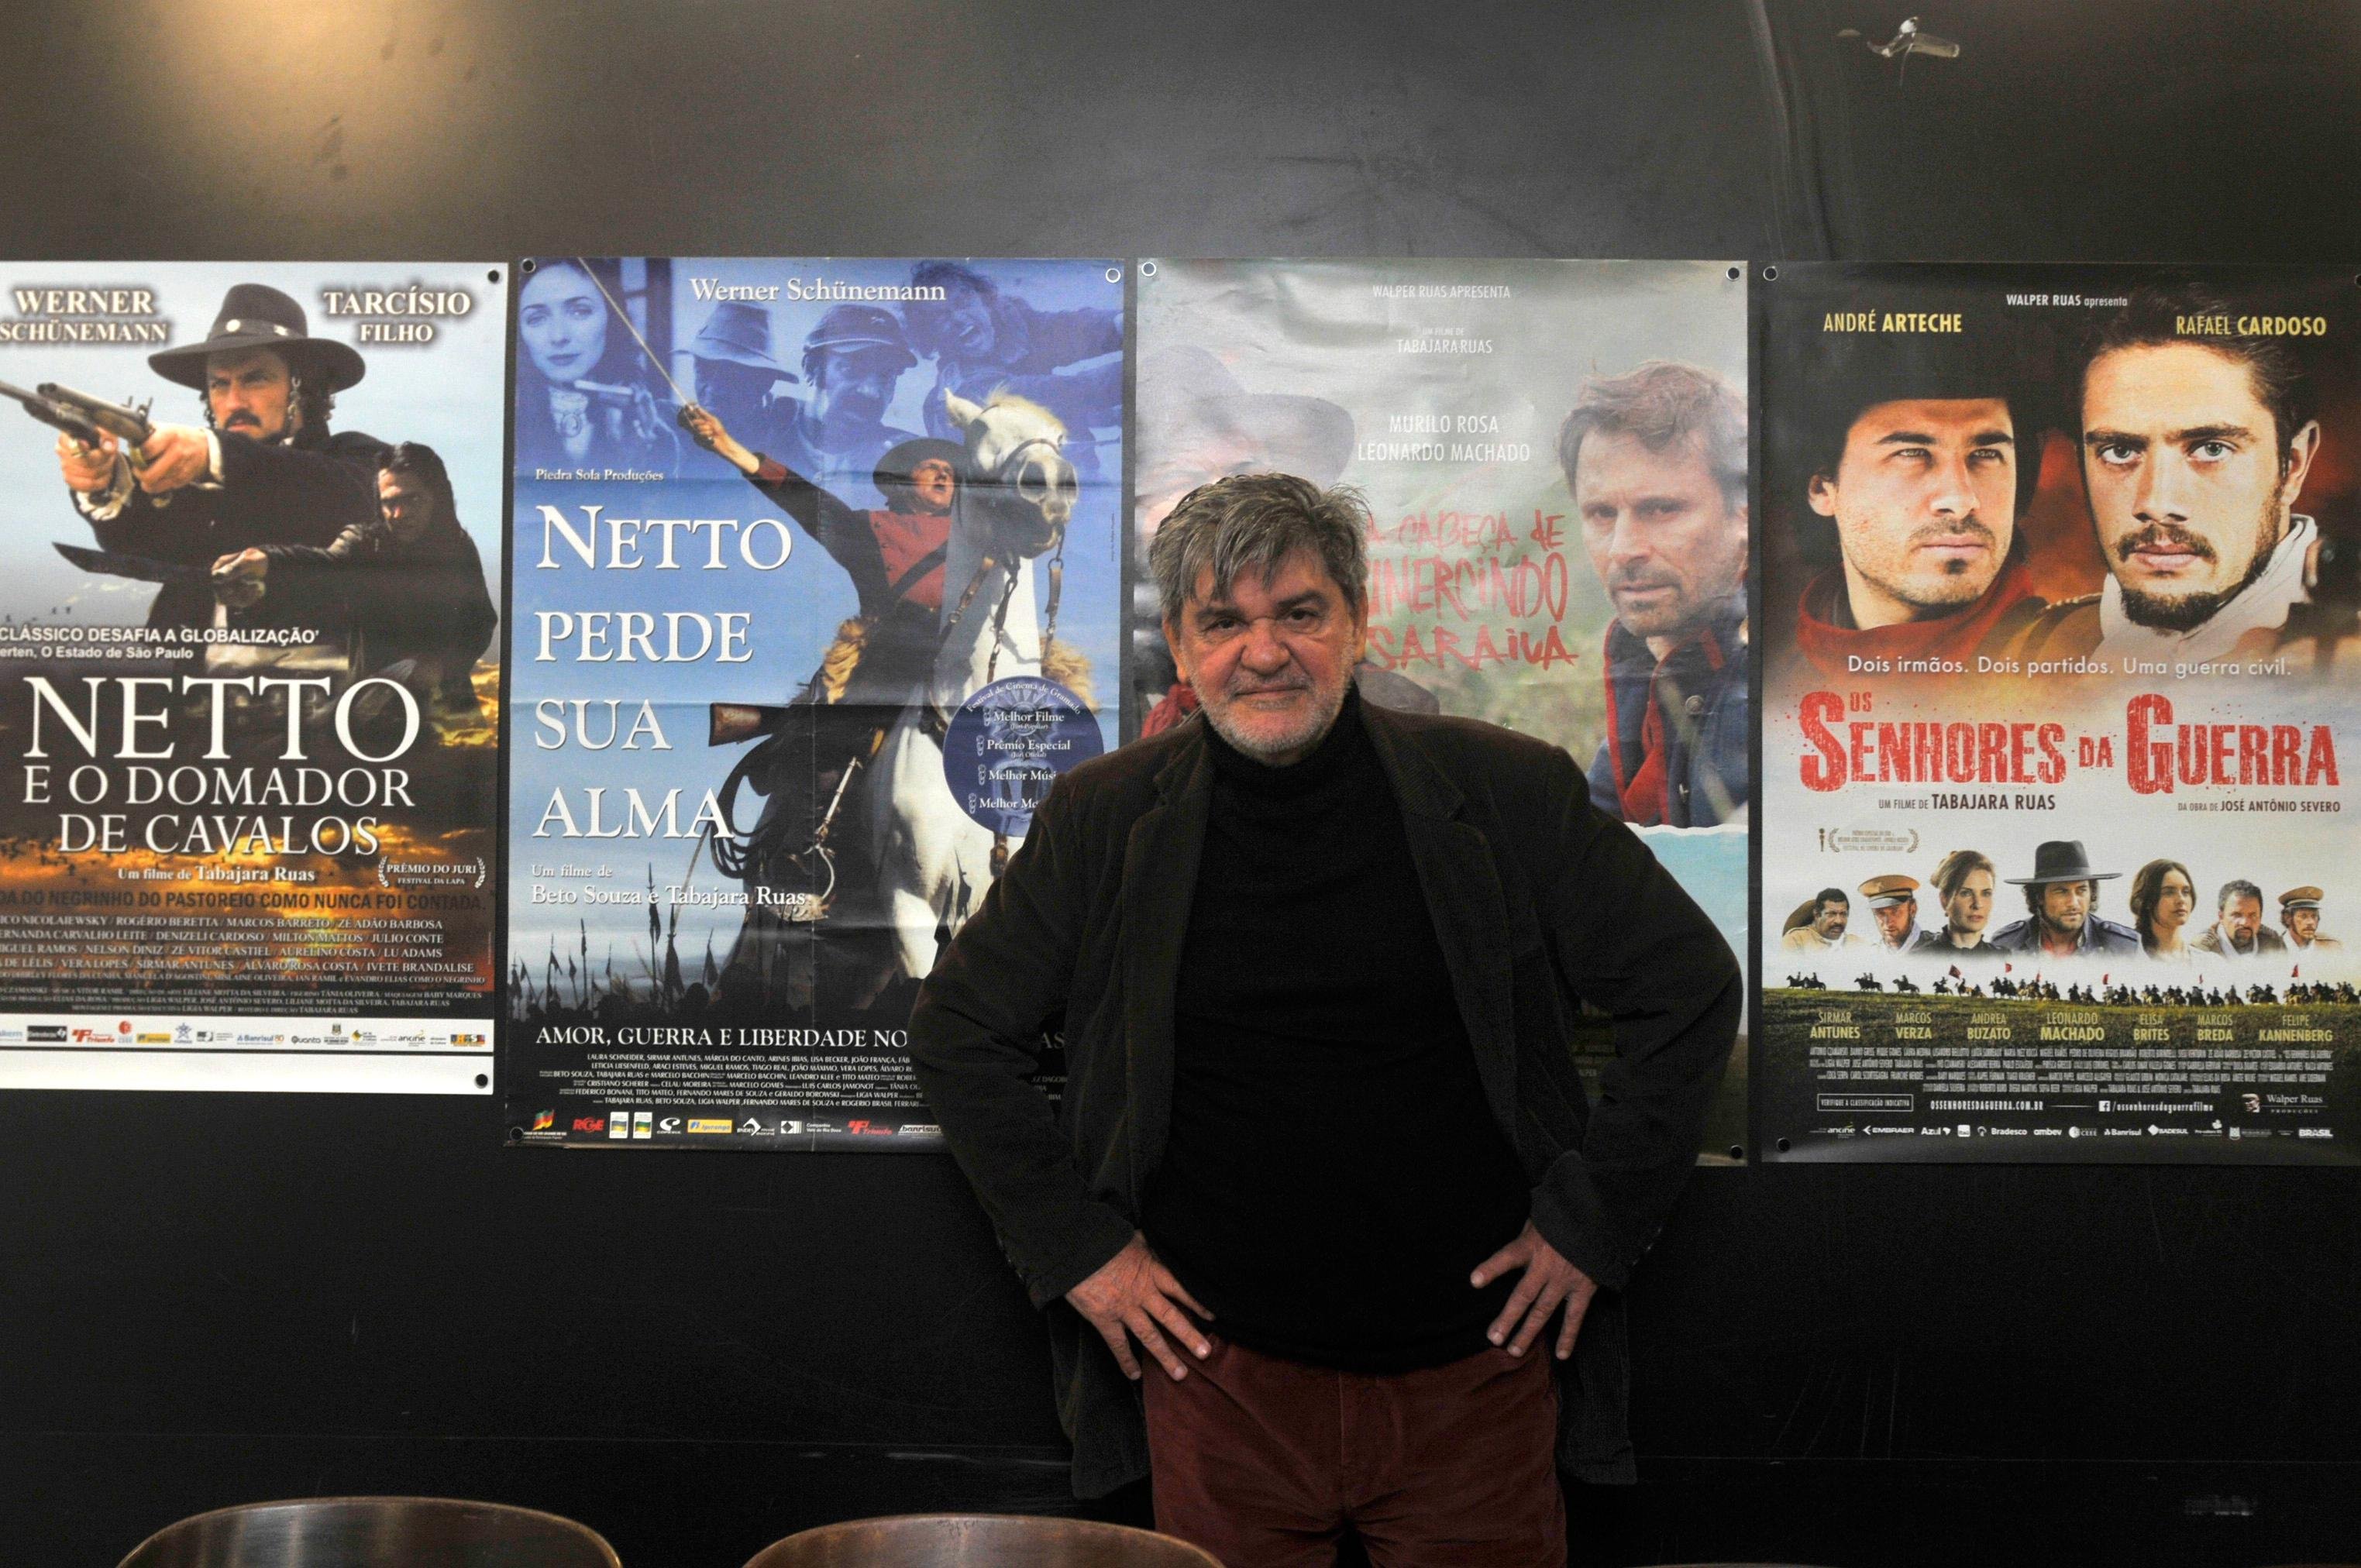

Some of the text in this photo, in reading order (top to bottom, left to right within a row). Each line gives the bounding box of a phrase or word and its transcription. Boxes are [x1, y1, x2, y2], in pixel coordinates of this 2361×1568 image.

[690, 279, 945, 301] Werner Schünemann
[1372, 285, 1510, 298] WALPER RUAS APRESENTA
[15, 290, 153, 314] WERNER
[324, 287, 471, 315] TARCÍSIO
[2007, 294, 2128, 309] WALPER RUAS apresenta
[1823, 309, 1962, 333] ANDRÉ ARTECHE
[2176, 316, 2327, 336] RAFAEL CARDOSO
[0, 319, 167, 341] SCHÜNEMANN
[360, 324, 433, 342] FILHO
[1396, 339, 1492, 354] TABAJARA RUAS
[1389, 415, 1499, 433] MURILO ROSA
[1358, 443, 1530, 462] LEONARDO MACHADO
[535, 468, 664, 483] Piedra Sola Produções
[535, 505, 792, 571] NETTO
[1398, 509, 1517, 554] CABEÇA
[0, 624, 83, 642] CLÁSSICO
[88, 628, 160, 642] DESAFIA
[163, 628, 176, 642] A
[534, 611, 753, 663] PERDE
[41, 646, 194, 658] O Estado de São Paulo
[1848, 655, 2291, 678] Dois irmãos. Dois partidos. Uma guerra civil.
[967, 682, 1081, 715] Festival de Cinema de Gramado
[1850, 691, 1872, 712] OS
[23, 676, 420, 762] NETTO
[993, 711, 1065, 722] Melhor Filme
[534, 699, 673, 751] SUA
[987, 739, 1070, 753] Prêmio Especial
[1799, 691, 2339, 795] SENHORES DA GUERRA
[989, 769, 1055, 780] Melhor Músi
[22, 765, 415, 808] E O DOMADOR
[979, 798, 1017, 809] Melhor
[1879, 794, 2055, 810] UM FILME DE TABAJARA RUAS
[2177, 799, 2341, 812] DA OBRA DE JOSÉ ANTÔNIO SEVERO
[532, 786, 734, 839] ALMA
[58, 813, 378, 856] DE CAVALOS
[118, 865, 315, 884] Um filme de Tabajara Ruas
[387, 863, 477, 874] PRÊMIO DO JURI
[532, 865, 612, 878] Um filme de
[49, 891, 133, 906] NEGRINHO
[139, 892, 160, 906] DO
[166, 892, 255, 908] PASTOREIO
[260, 893, 308, 908] COMO
[315, 893, 371, 909] NUNCA
[377, 894, 401, 909] FOI
[532, 885, 805, 910] Beto Souza e Tabajara Ruas
[227, 917, 442, 930] MARCOS BARRETO ADÃO BARBOSA
[1819, 1012, 1851, 1023] SIRMAR
[1895, 1013, 1932, 1024] MARCOS
[1971, 1013, 2006, 1024] ANDREA
[2047, 1013, 2098, 1025] LEONARDO
[2139, 1014, 2163, 1025] ELISA
[2198, 1014, 2233, 1026] MARCOS
[2283, 1015, 2309, 1026] FELIPE
[536, 1027, 611, 1046] AMOR,
[618, 1028, 713, 1045] GUERRA
[720, 1029, 732, 1045] E
[739, 1029, 866, 1047] LIBERDADE
[1810, 1026, 1860, 1038] ANTUNES
[1895, 1027, 1933, 1039] VERZA
[1967, 1027, 2011, 1040] BUZATO
[2040, 1027, 2105, 1040] MACHADO
[2133, 1029, 2169, 1040] BRITES
[2198, 1030, 2233, 1041] BREDA
[2259, 1030, 2333, 1041] KANNENBERG
[2266, 1095, 2322, 1105] Walper Ruas
